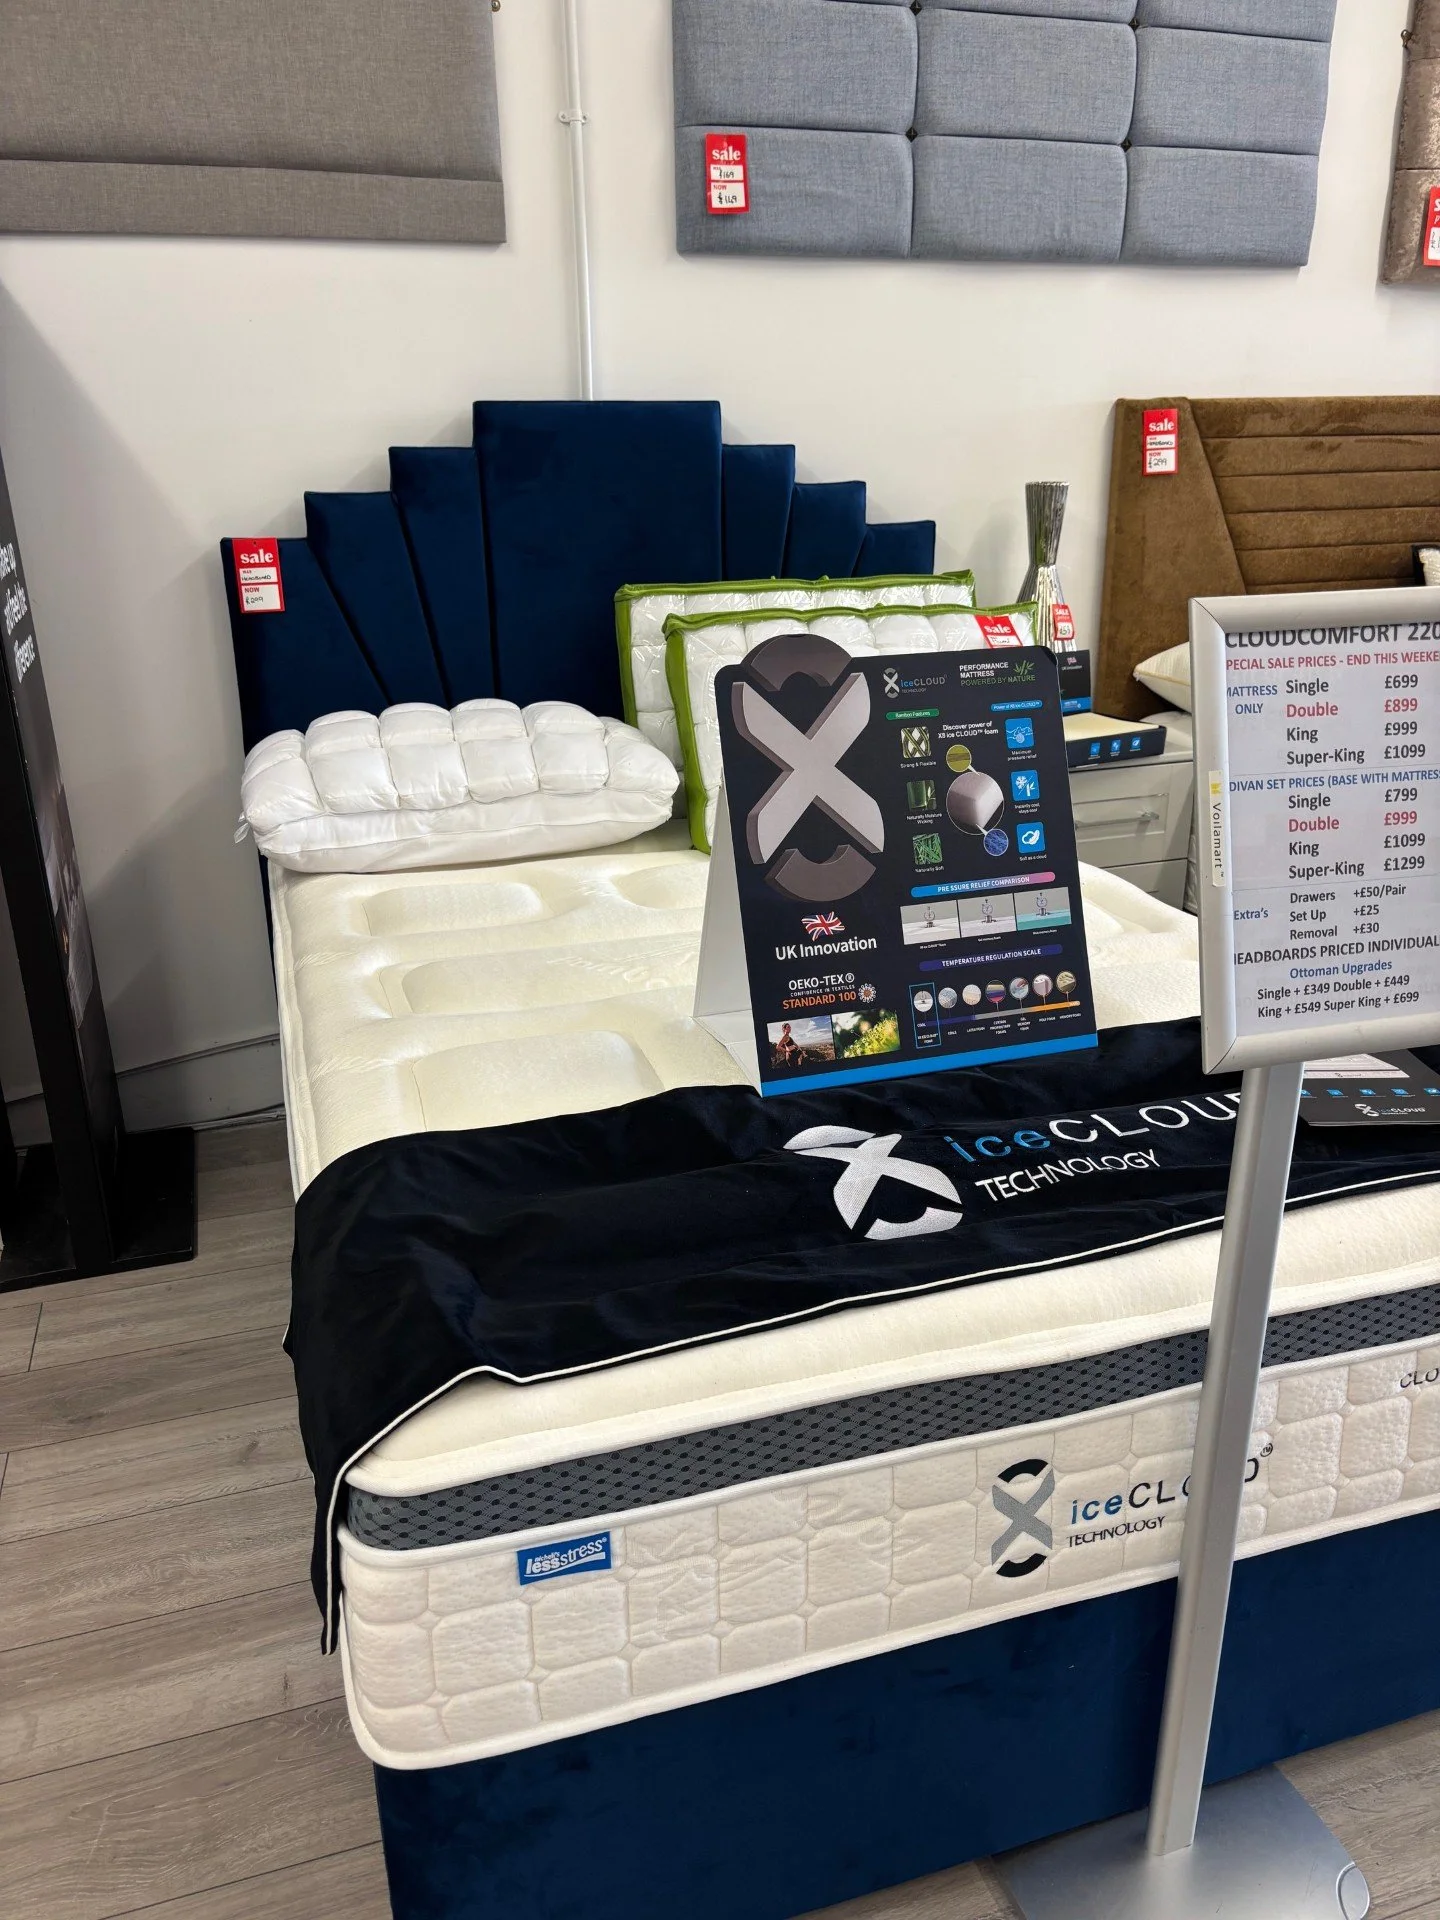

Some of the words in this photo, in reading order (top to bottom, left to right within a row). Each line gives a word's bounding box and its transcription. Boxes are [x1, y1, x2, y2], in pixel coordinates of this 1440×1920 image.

[712, 146, 741, 161] sale
[1148, 418, 1175, 432] sale
[240, 549, 274, 564] sale
[984, 624, 1011, 634] sale
[1225, 623, 1403, 648] CLOUDCOMFORT
[959, 662, 1009, 672] PERFORMANCE
[1267, 657, 1295, 669] SALE
[1298, 655, 1337, 667] PRICES
[1347, 653, 1371, 666] END
[1373, 652, 1398, 665] THIS
[960, 670, 995, 679] MATTRESS
[960, 678, 997, 686] POWERED
[1007, 675, 1036, 683] NATURE
[1285, 678, 1329, 696] Single
[1384, 674, 1419, 689] £699
[1235, 703, 1264, 715] ONLY
[1286, 702, 1339, 718] Double
[1384, 698, 1418, 713] £899
[943, 723, 967, 731] Discover
[1286, 726, 1318, 743] King
[1384, 721, 1418, 736] £999
[1286, 748, 1365, 767] Super-King
[1384, 743, 1426, 759] £1099
[1229, 780, 1264, 792] DIVAN
[1266, 778, 1286, 790] SET
[1288, 776, 1325, 788] PRICES
[1327, 774, 1358, 788] (BASE
[1360, 772, 1389, 784] WITH
[1288, 793, 1331, 811] Single
[1384, 788, 1418, 803] £799
[1288, 816, 1340, 832] Double
[1384, 811, 1418, 826] £999
[1288, 842, 1320, 857] King
[1383, 833, 1426, 849] £1099
[1288, 861, 1365, 880] Super-King
[1383, 856, 1425, 872] £1299
[970, 881, 991, 889] RELIEF
[991, 876, 1030, 887] COMPARISON
[1290, 890, 1336, 904] Drawers
[1353, 884, 1407, 899] +£50/Pair
[1290, 911, 1308, 922] Set
[1310, 909, 1327, 922] Up
[1353, 904, 1380, 916] +£25
[1290, 926, 1338, 940] Removal
[1353, 922, 1380, 934] +£30
[775, 945, 798, 961] UK
[800, 936, 877, 958] Innovation
[942, 955, 985, 967] TEMPERATURE
[985, 951, 1022, 962] REGULATION
[1022, 949, 1042, 957] SCALE
[1320, 942, 1365, 958] PRICED
[1290, 965, 1339, 979] Ottoman
[1342, 960, 1393, 976] Upgrades
[832, 984, 855, 992] TEXTILES
[1257, 986, 1291, 1000] Single
[1303, 983, 1330, 995] £349
[1333, 978, 1372, 993] Double
[1384, 975, 1410, 987] £449
[782, 994, 836, 1010] STANDARD
[838, 991, 857, 1002] 100
[1258, 1006, 1282, 1019] King
[1294, 1002, 1321, 1015] £549
[1324, 997, 1356, 1012] Super
[1358, 994, 1381, 1008] King
[1393, 991, 1420, 1004] £699
[974, 1149, 1161, 1202] TECHNOLOGY
[1066, 1516, 1166, 1548] TECHNOLOGY
